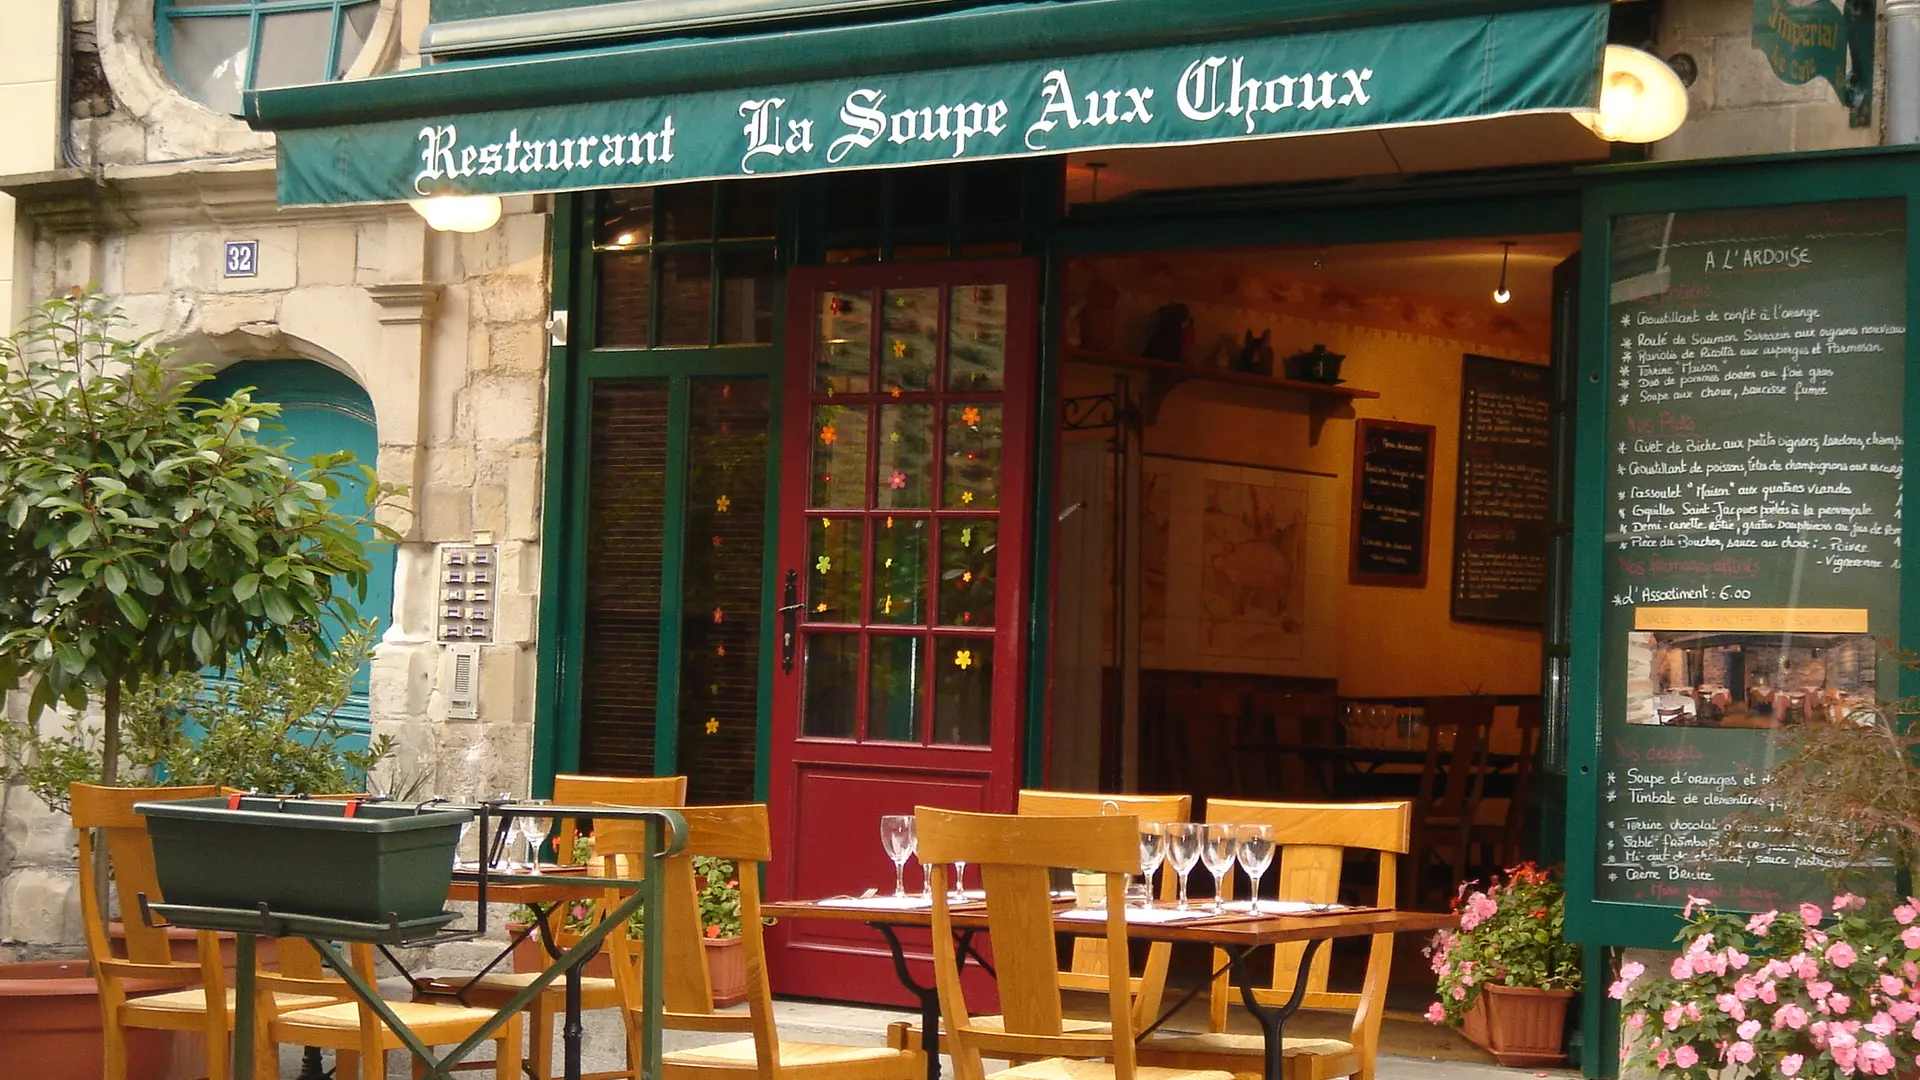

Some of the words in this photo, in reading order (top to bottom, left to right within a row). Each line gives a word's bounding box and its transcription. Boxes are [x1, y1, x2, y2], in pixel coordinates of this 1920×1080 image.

[414, 115, 675, 196] Restaurant
[739, 98, 815, 174] La
[826, 88, 1008, 163] Soupe
[1024, 68, 1154, 150] Aux
[1176, 55, 1373, 134] Choux
[228, 246, 251, 271] 32
[1705, 250, 1715, 272] A
[1722, 246, 1812, 270] L'ARDOISE
[1637, 309, 1700, 325] Croustillant
[1705, 310, 1719, 321] de
[1724, 307, 1756, 324] confit
[1760, 308, 1770, 320] à
[1773, 304, 1821, 323] l'orange
[1637, 331, 1668, 347] Roulé
[1672, 334, 1686, 345] de
[1691, 333, 1738, 345] Saumon
[1794, 328, 1816, 338] aux
[1637, 349, 1677, 364] Raviolis
[1681, 348, 1695, 359] de
[1700, 346, 1736, 358] Ricotta
[1739, 347, 1758, 356] aux
[1762, 345, 1809, 362] asperges
[1812, 342, 1822, 354] et
[1825, 342, 1884, 354] Parmesan
[1637, 364, 1674, 376] Terrine
[1638, 378, 1660, 388] Duo
[1664, 376, 1676, 386] de
[1680, 375, 1720, 388] pommes
[1761, 369, 1777, 378] au
[1781, 364, 1804, 381] foie
[1808, 368, 1834, 384] gras
[1640, 390, 1669, 404] Soupe
[1673, 390, 1693, 399] aux
[1741, 383, 1787, 396] saucisse
[1634, 439, 1663, 453] Civet
[1666, 441, 1683, 454] de
[1686, 439, 1721, 452] Biche
[1722, 438, 1744, 449] aux
[1747, 432, 1776, 451] petits
[1628, 458, 1687, 476] Croustillant
[1689, 461, 1703, 474] de
[1768, 459, 1783, 471] de
[1785, 459, 1848, 475] champignons
[1849, 463, 1868, 471] aux
[1630, 484, 1682, 499] Cassoulet
[1737, 486, 1758, 495] aux
[1762, 481, 1805, 501] quatres
[1632, 503, 1675, 522] Coquilles
[1682, 501, 1758, 520] Saint-Jacques
[1791, 502, 1800, 515] à
[1803, 504, 1815, 516] la
[1818, 502, 1874, 522] provençale
[1742, 519, 1776, 535] gratin
[1776, 520, 1832, 533] Dauphinois
[1834, 523, 1850, 532] au
[1850, 522, 1868, 538] jus
[1869, 522, 1883, 535] de
[1630, 534, 1658, 547] Pièce
[1660, 535, 1675, 547] du
[1726, 539, 1758, 548] sauce
[1760, 539, 1778, 548] au
[1719, 585, 1751, 600] 6.00
[1627, 767, 1666, 788] Soupe
[1670, 770, 1738, 792] d'oranges
[1743, 772, 1757, 785] et
[1628, 787, 1677, 804] Timbale
[1683, 794, 1698, 804] de
[1623, 817, 1664, 831] Terrine
[1755, 855, 1790, 865] sauce
